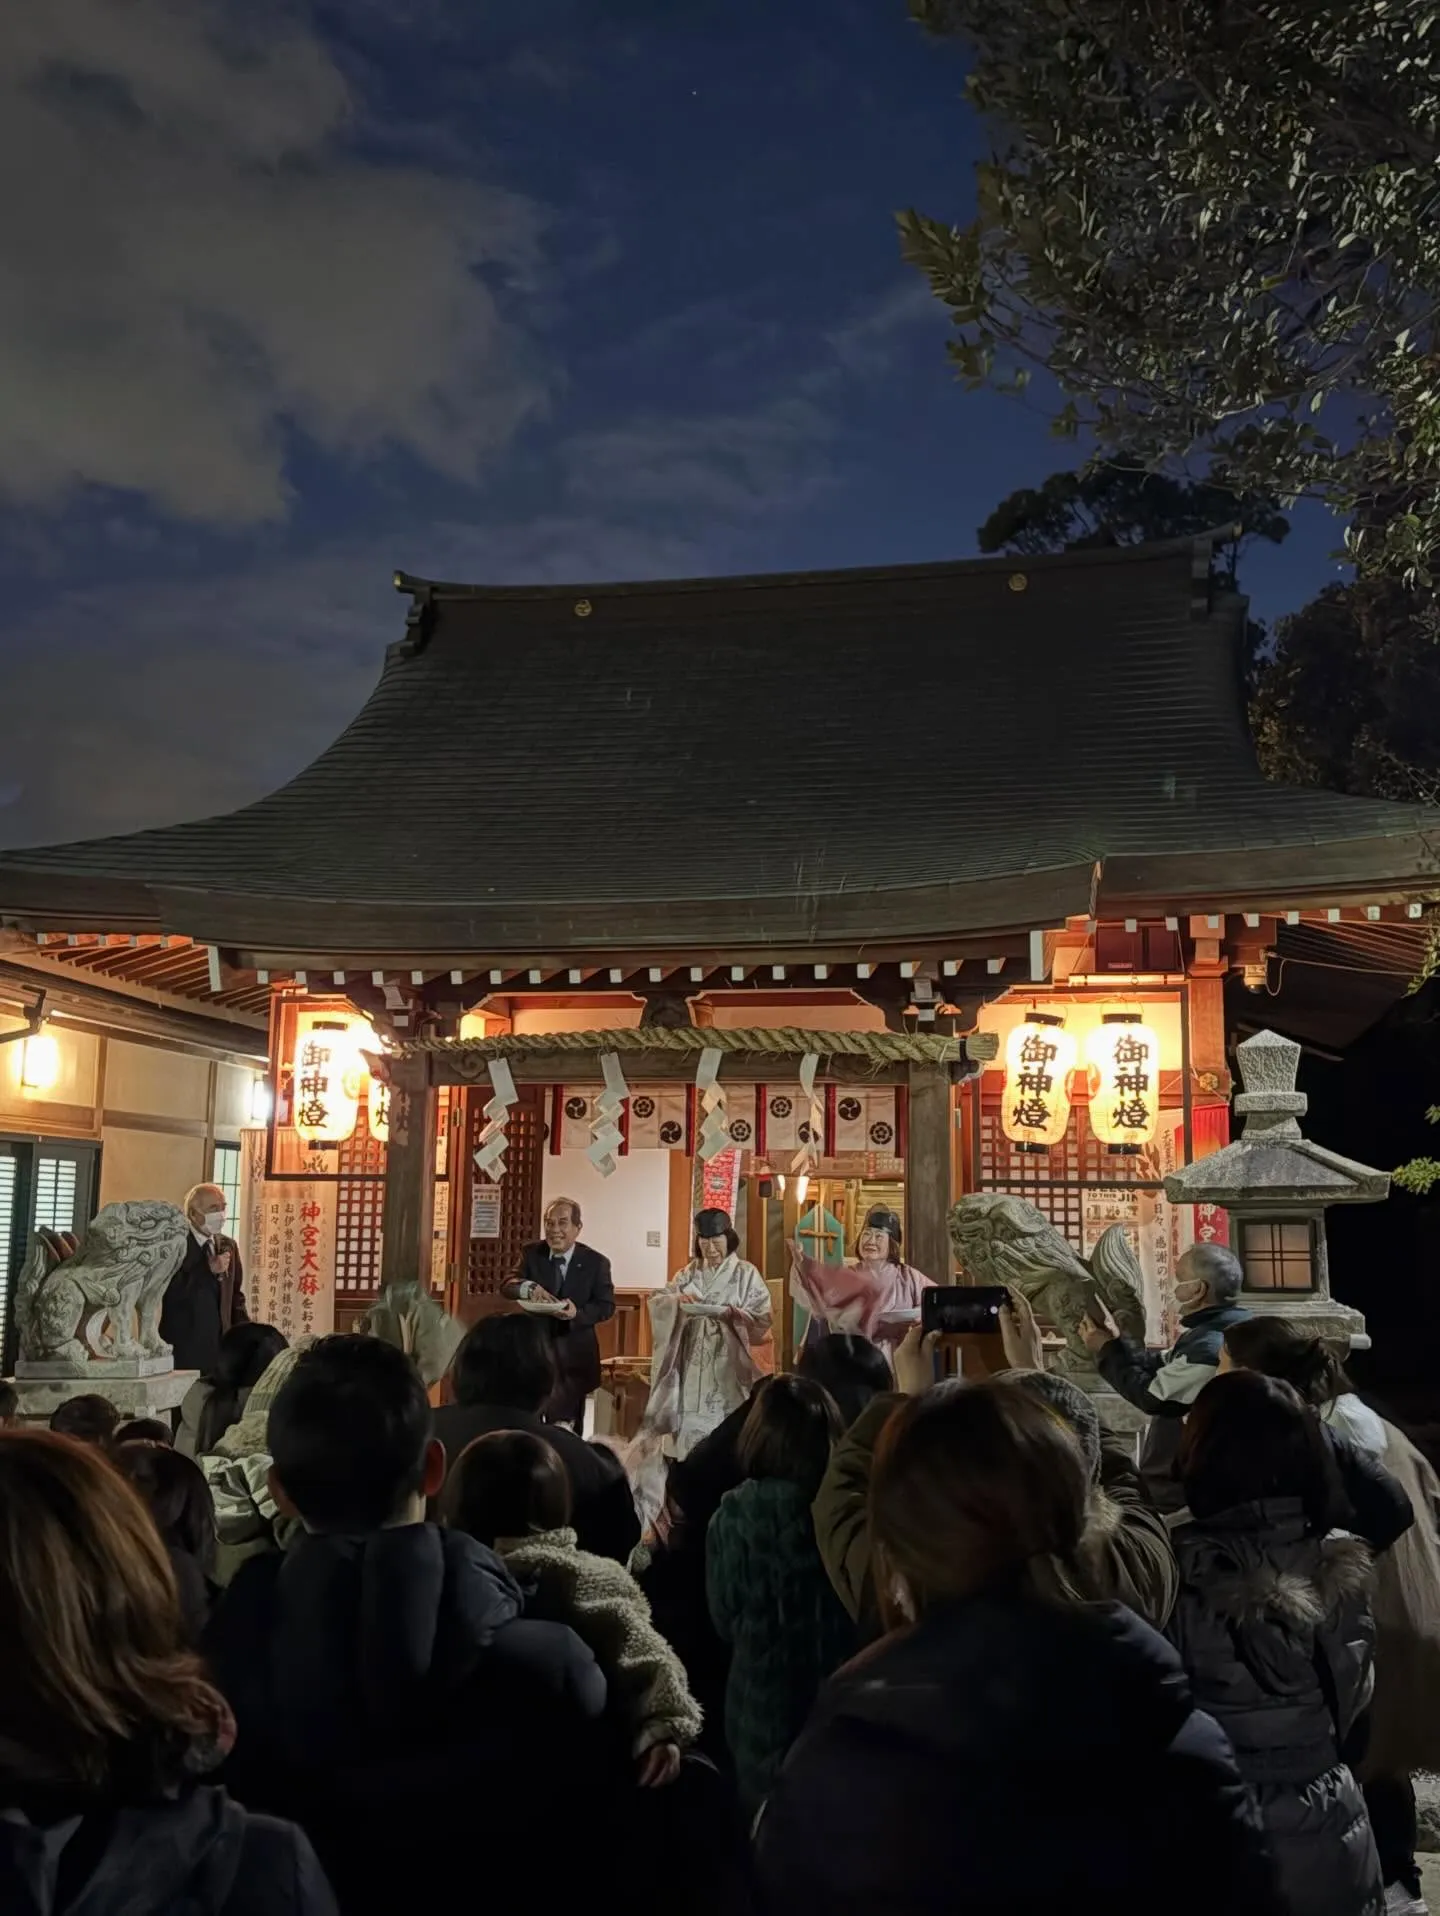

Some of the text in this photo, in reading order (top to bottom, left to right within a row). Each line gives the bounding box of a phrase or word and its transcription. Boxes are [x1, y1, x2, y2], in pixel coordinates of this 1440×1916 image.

[1013, 1034, 1058, 1131] 御神燈
[1112, 1034, 1150, 1130] 御神燈
